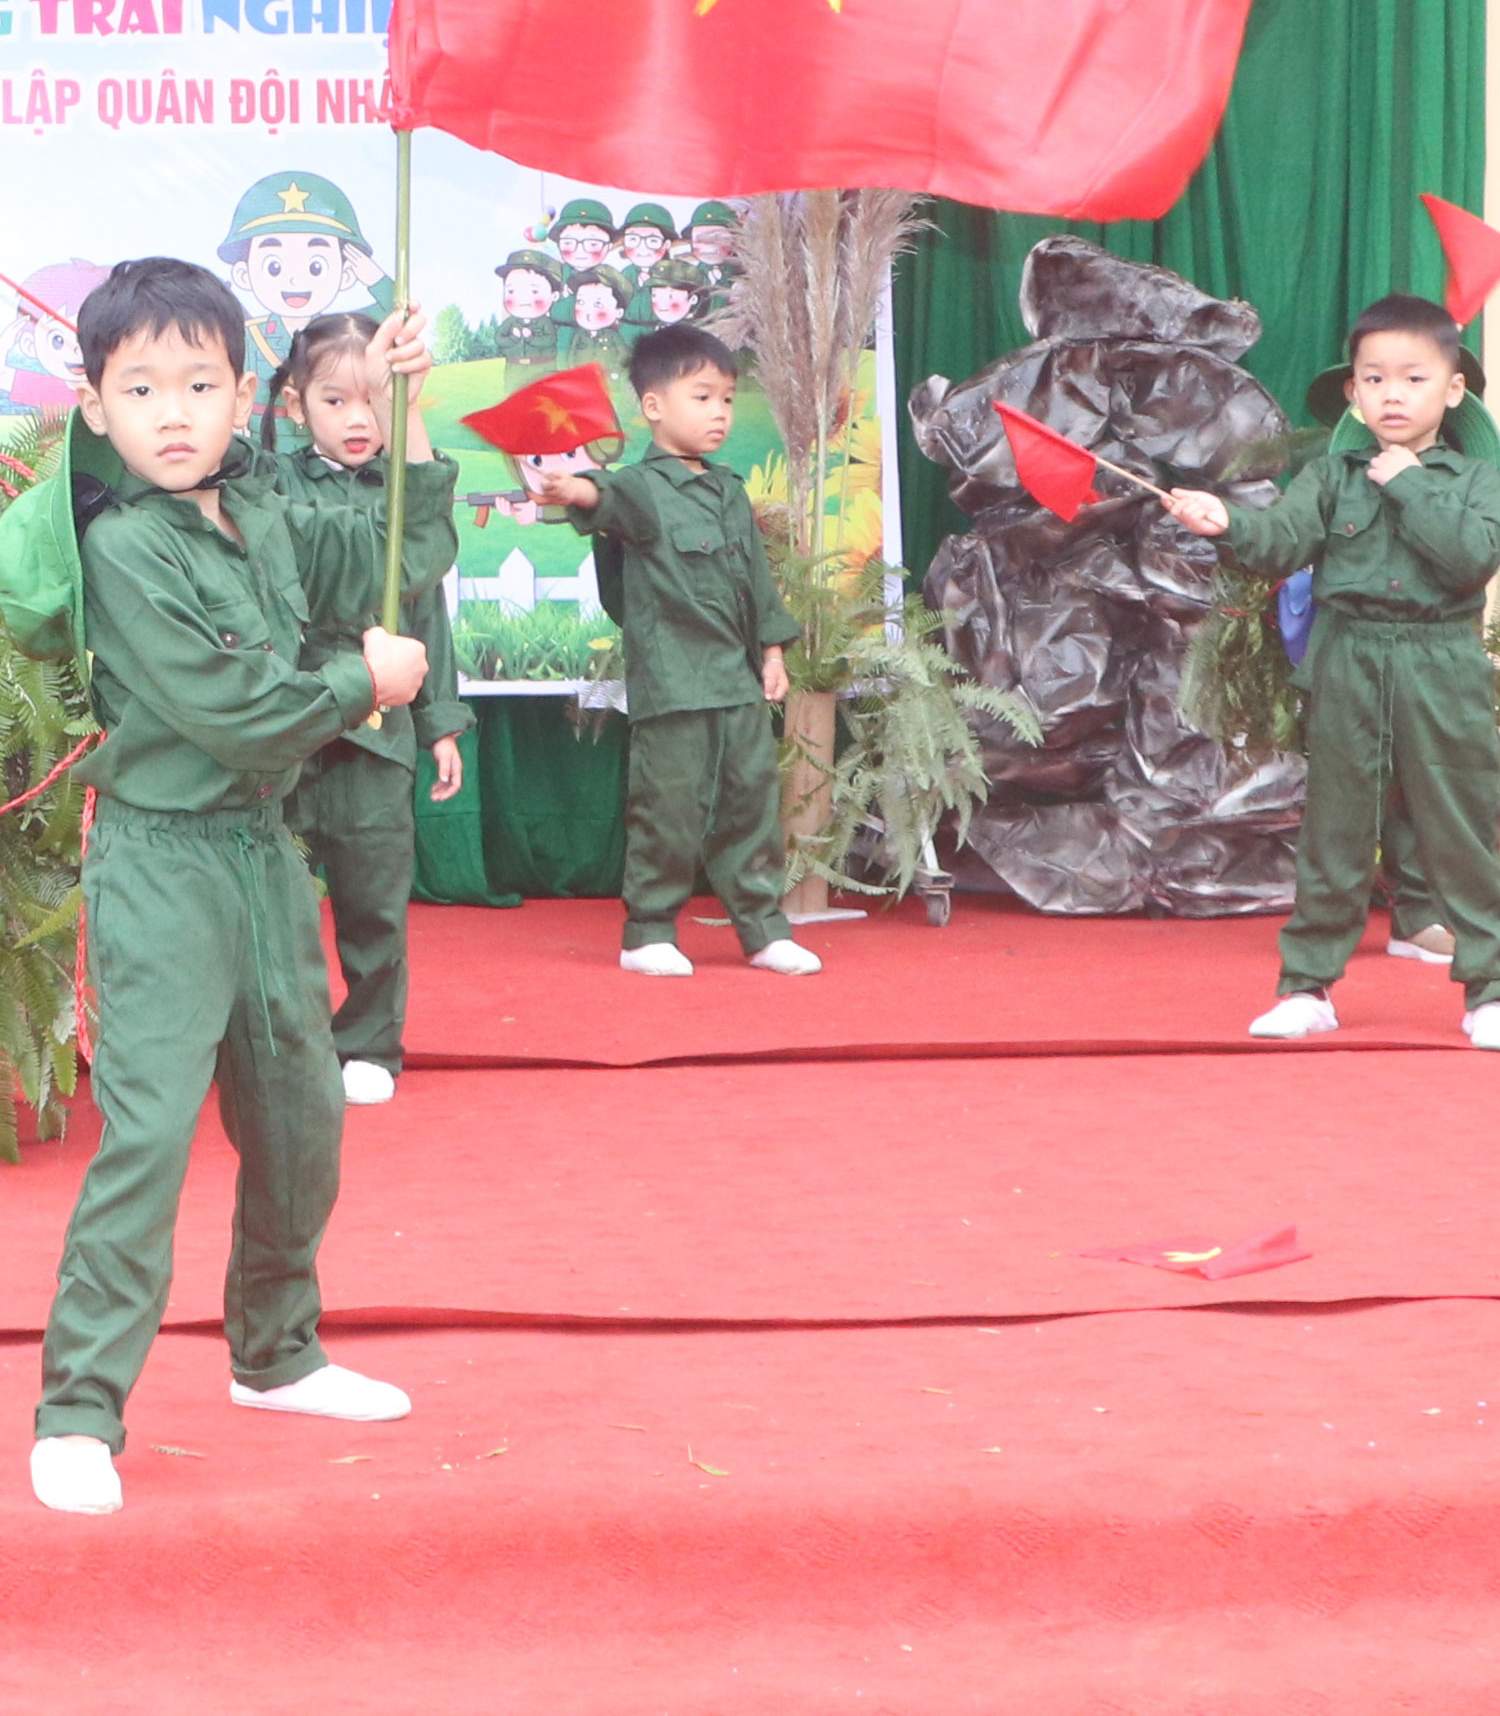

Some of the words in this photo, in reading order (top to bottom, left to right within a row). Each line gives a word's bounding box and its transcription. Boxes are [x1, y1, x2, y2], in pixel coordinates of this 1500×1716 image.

[2, 69, 81, 135] LẬP
[97, 69, 214, 128] QUÂN
[228, 69, 300, 135] ĐỘI
